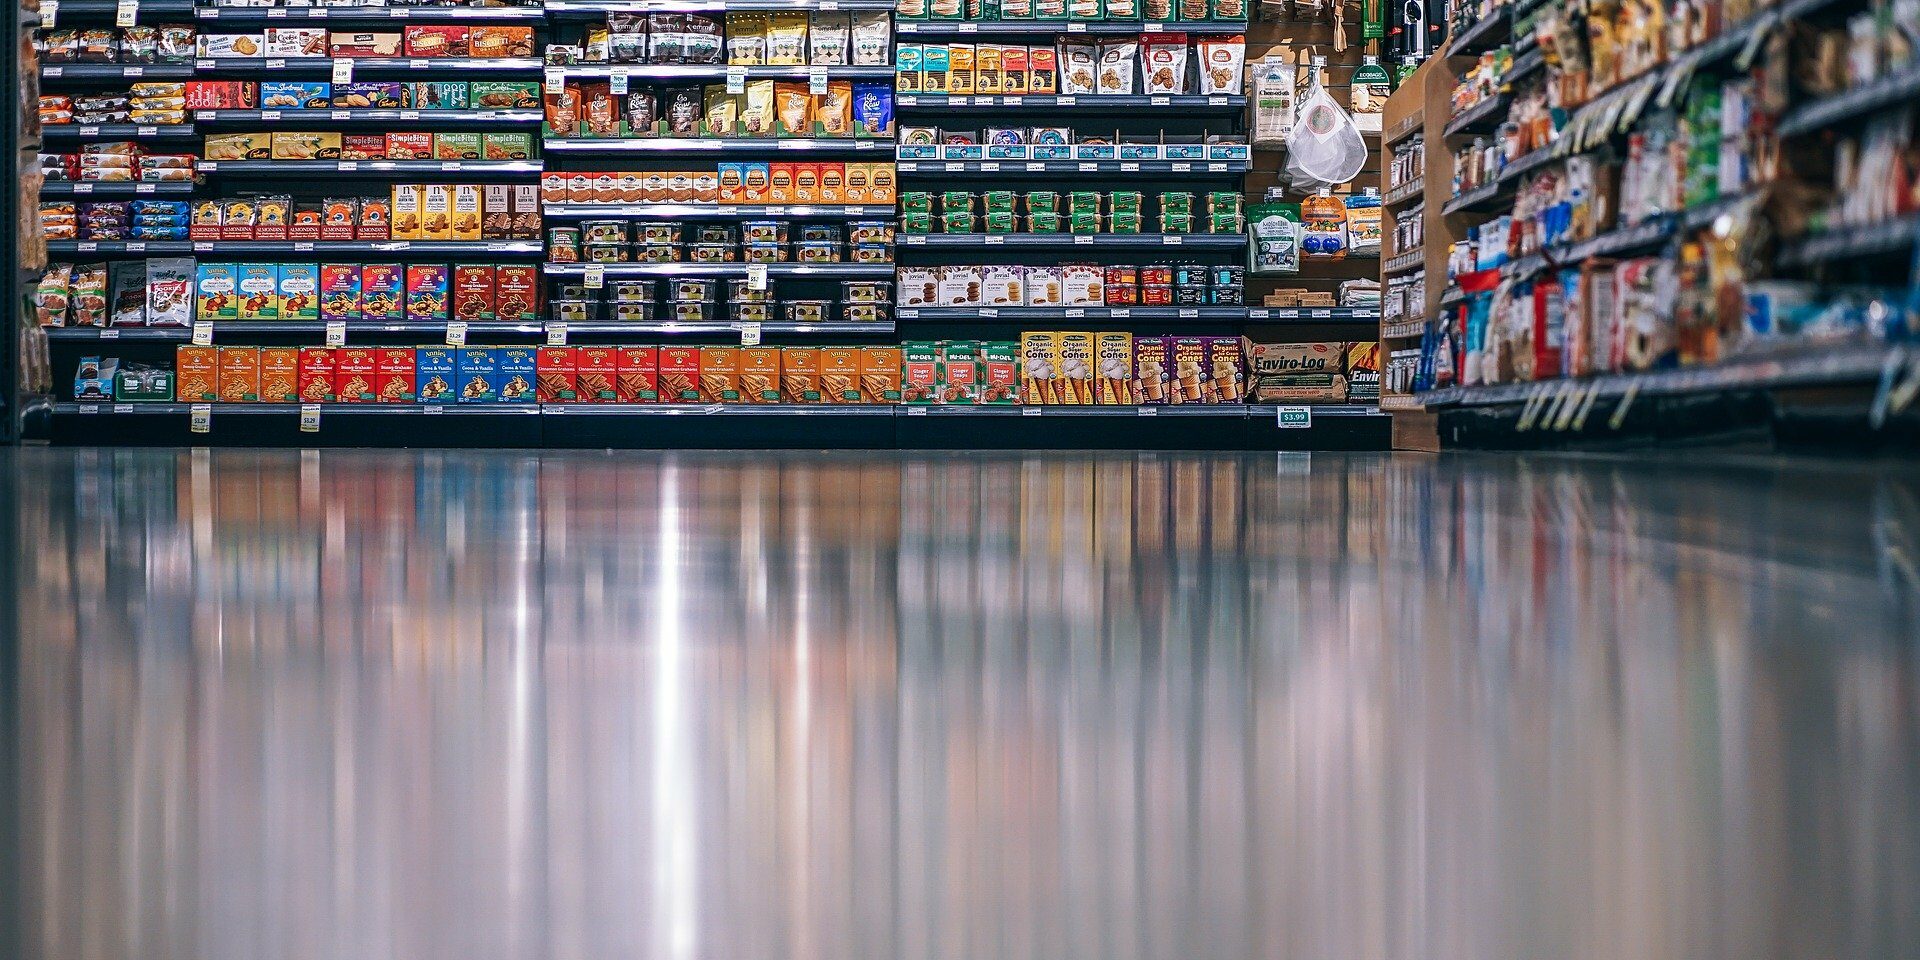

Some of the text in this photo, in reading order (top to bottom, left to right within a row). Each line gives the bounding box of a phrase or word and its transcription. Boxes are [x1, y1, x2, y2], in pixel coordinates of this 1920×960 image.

[594, 92, 605, 101] Go
[632, 92, 644, 100] Go
[676, 93, 687, 102] Go
[866, 92, 877, 101] Go
[558, 98, 573, 109] Raw
[591, 99, 608, 110] Raw
[629, 98, 647, 109] Raw
[673, 100, 690, 111] Raw
[788, 97, 805, 109] Raw
[863, 99, 881, 110] Raw
[391, 134, 429, 142] SimpleBites
[439, 134, 477, 142] SimpleBites
[487, 134, 525, 142] SimpleBites
[403, 186, 410, 194] n
[433, 186, 440, 194] n
[463, 186, 470, 194] n
[493, 186, 500, 194] n
[522, 186, 530, 194] n
[1138, 344, 1164, 352] Organic
[1176, 344, 1203, 352] Organic
[1212, 344, 1239, 352] Organic
[1025, 351, 1054, 359] Cones
[1061, 351, 1089, 359] Cones
[1100, 351, 1128, 359] Cones
[1137, 354, 1165, 362] Cones
[1175, 354, 1203, 362] Cones
[1211, 354, 1239, 362] Cones
[1255, 355, 1327, 371] Enviro-Log
[1284, 413, 1306, 422] $3.99
